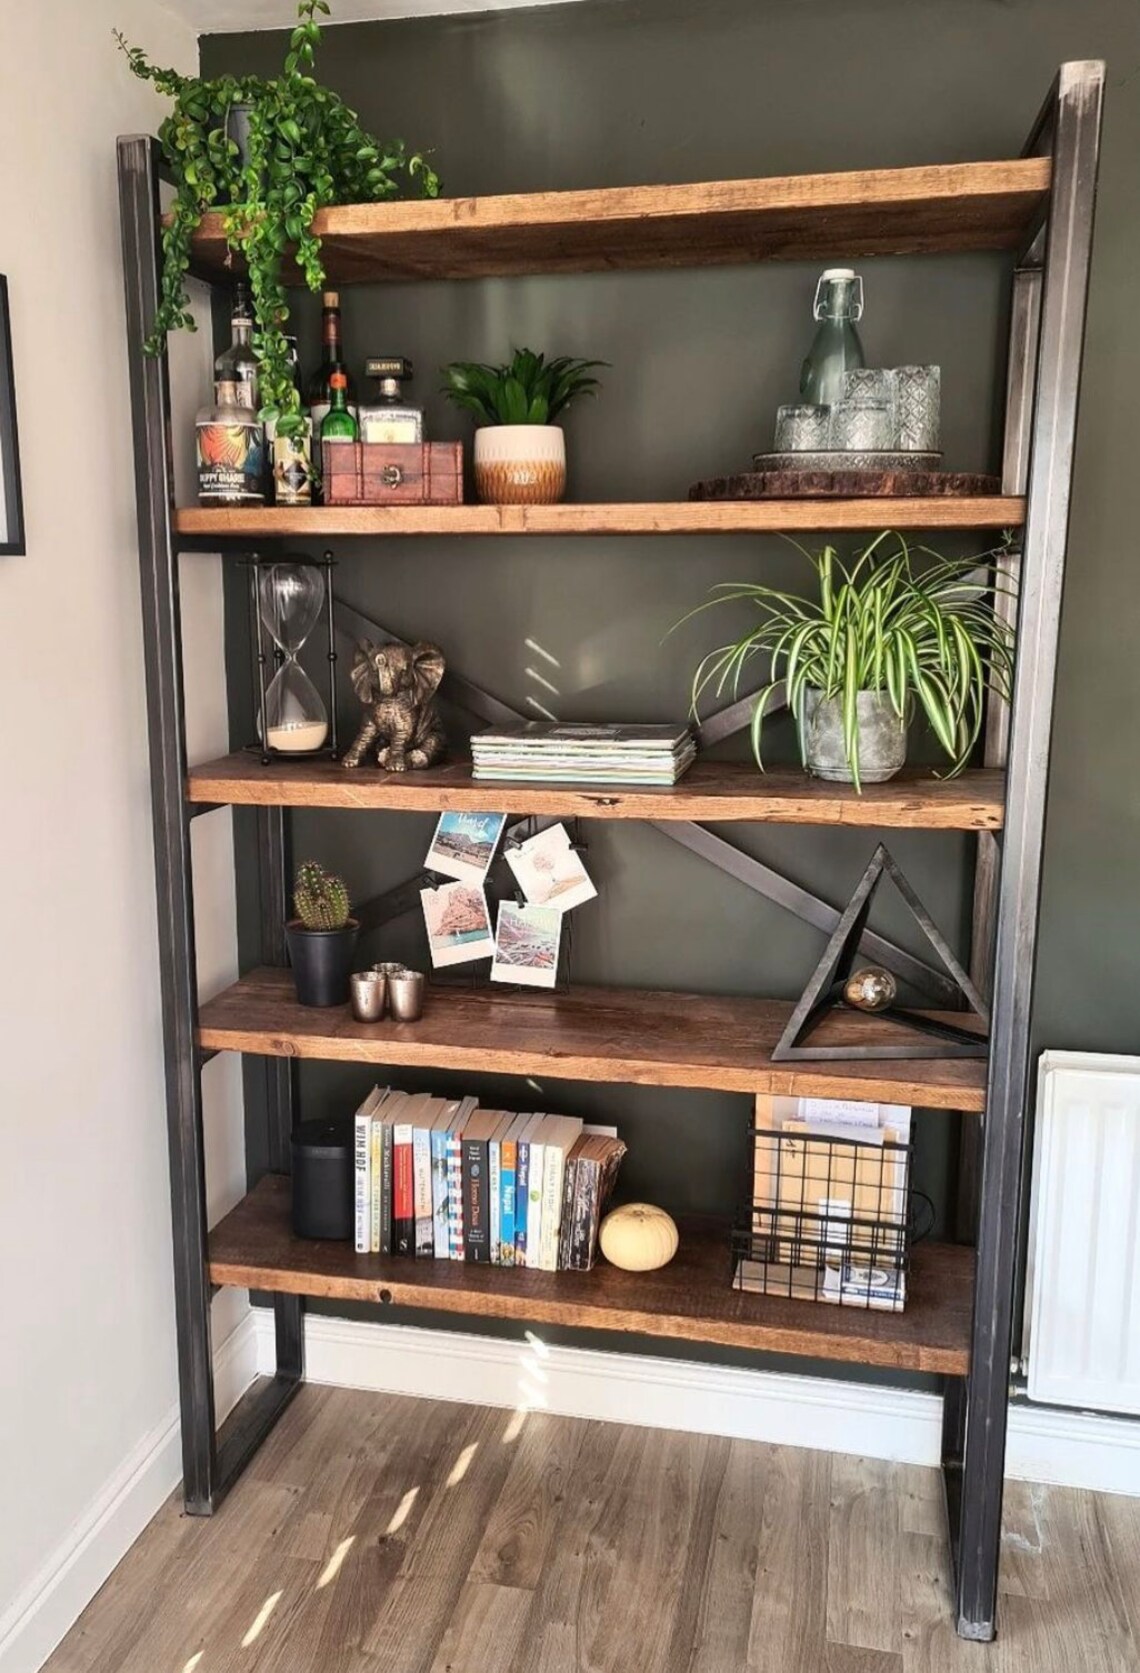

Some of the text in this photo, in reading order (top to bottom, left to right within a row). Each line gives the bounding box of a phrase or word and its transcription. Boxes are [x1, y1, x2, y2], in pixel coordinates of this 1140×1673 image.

[356, 1125, 366, 1172] WIM HOF
[518, 1164, 527, 1186] Nepal
[470, 1178, 480, 1205] Homo
[502, 1185, 513, 1214] Nepal
[470, 1206, 480, 1227] Deus
